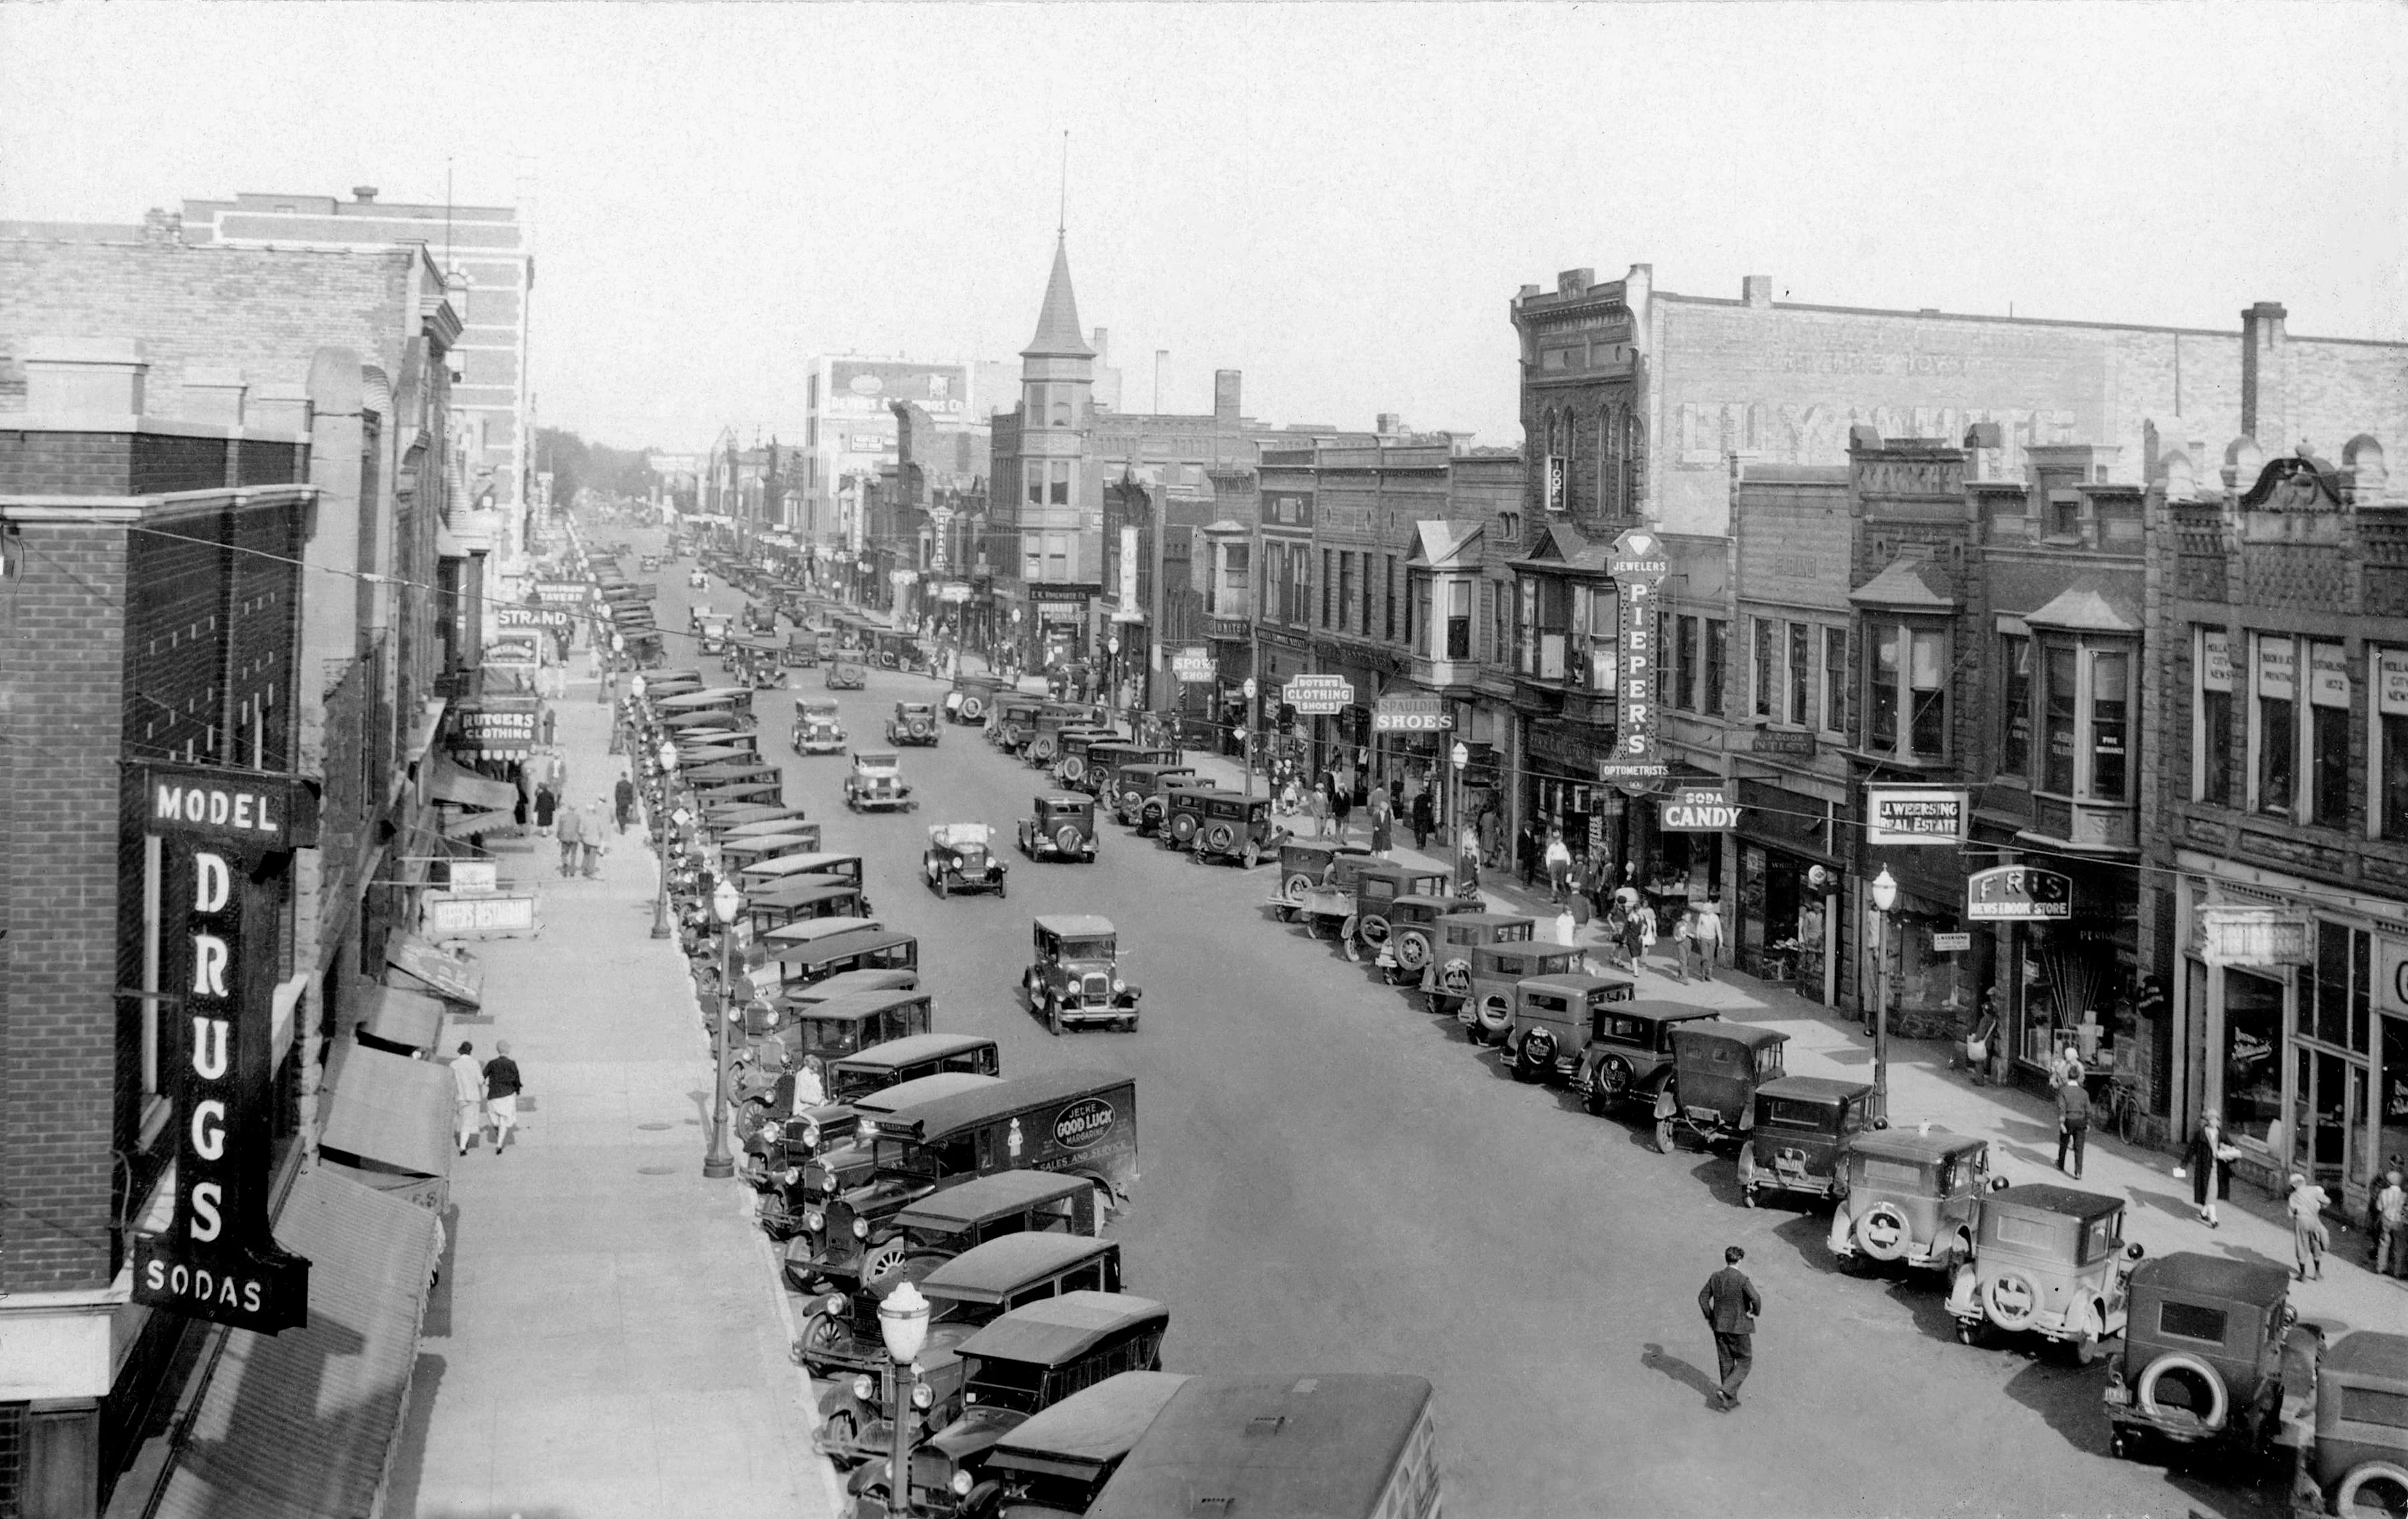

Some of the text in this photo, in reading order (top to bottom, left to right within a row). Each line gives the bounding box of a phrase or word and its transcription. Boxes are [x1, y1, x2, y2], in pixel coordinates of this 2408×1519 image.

[1613, 562, 1666, 572] JEWELERS
[540, 593, 583, 602] TAVERN
[499, 610, 567, 625] STRAND
[1217, 623, 1247, 634] UNITED
[1173, 658, 1219, 671] SPORT
[1629, 584, 1648, 753] PIEPER'S
[1182, 672, 1211, 680] SHOP
[1288, 689, 1350, 700] CLOTHING
[1302, 702, 1335, 711] SHOES
[1379, 700, 1451, 712] SPAULDING
[463, 713, 535, 728] RUTGERS
[1376, 715, 1453, 729] SHOES
[466, 728, 532, 739] CLOTHING
[1604, 766, 1669, 776] OPTOMETRISTS
[1685, 792, 1724, 804] SODA
[157, 784, 278, 831] MODEL
[1665, 807, 1743, 827] CANDY
[1880, 817, 1958, 833] REAL ESTATE
[1980, 872, 2063, 902] FRIS
[2005, 902, 2030, 914] BOOK
[2034, 902, 2067, 914] STORE
[190, 852, 230, 1242] DRUGS
[1056, 1117, 1085, 1138] GOOD
[1086, 1110, 1113, 1129] LUCK
[1066, 1127, 1105, 1145] MARGARINE
[1040, 1141, 1126, 1171] SALES AND SERVICE
[146, 1259, 261, 1312] SODAS
